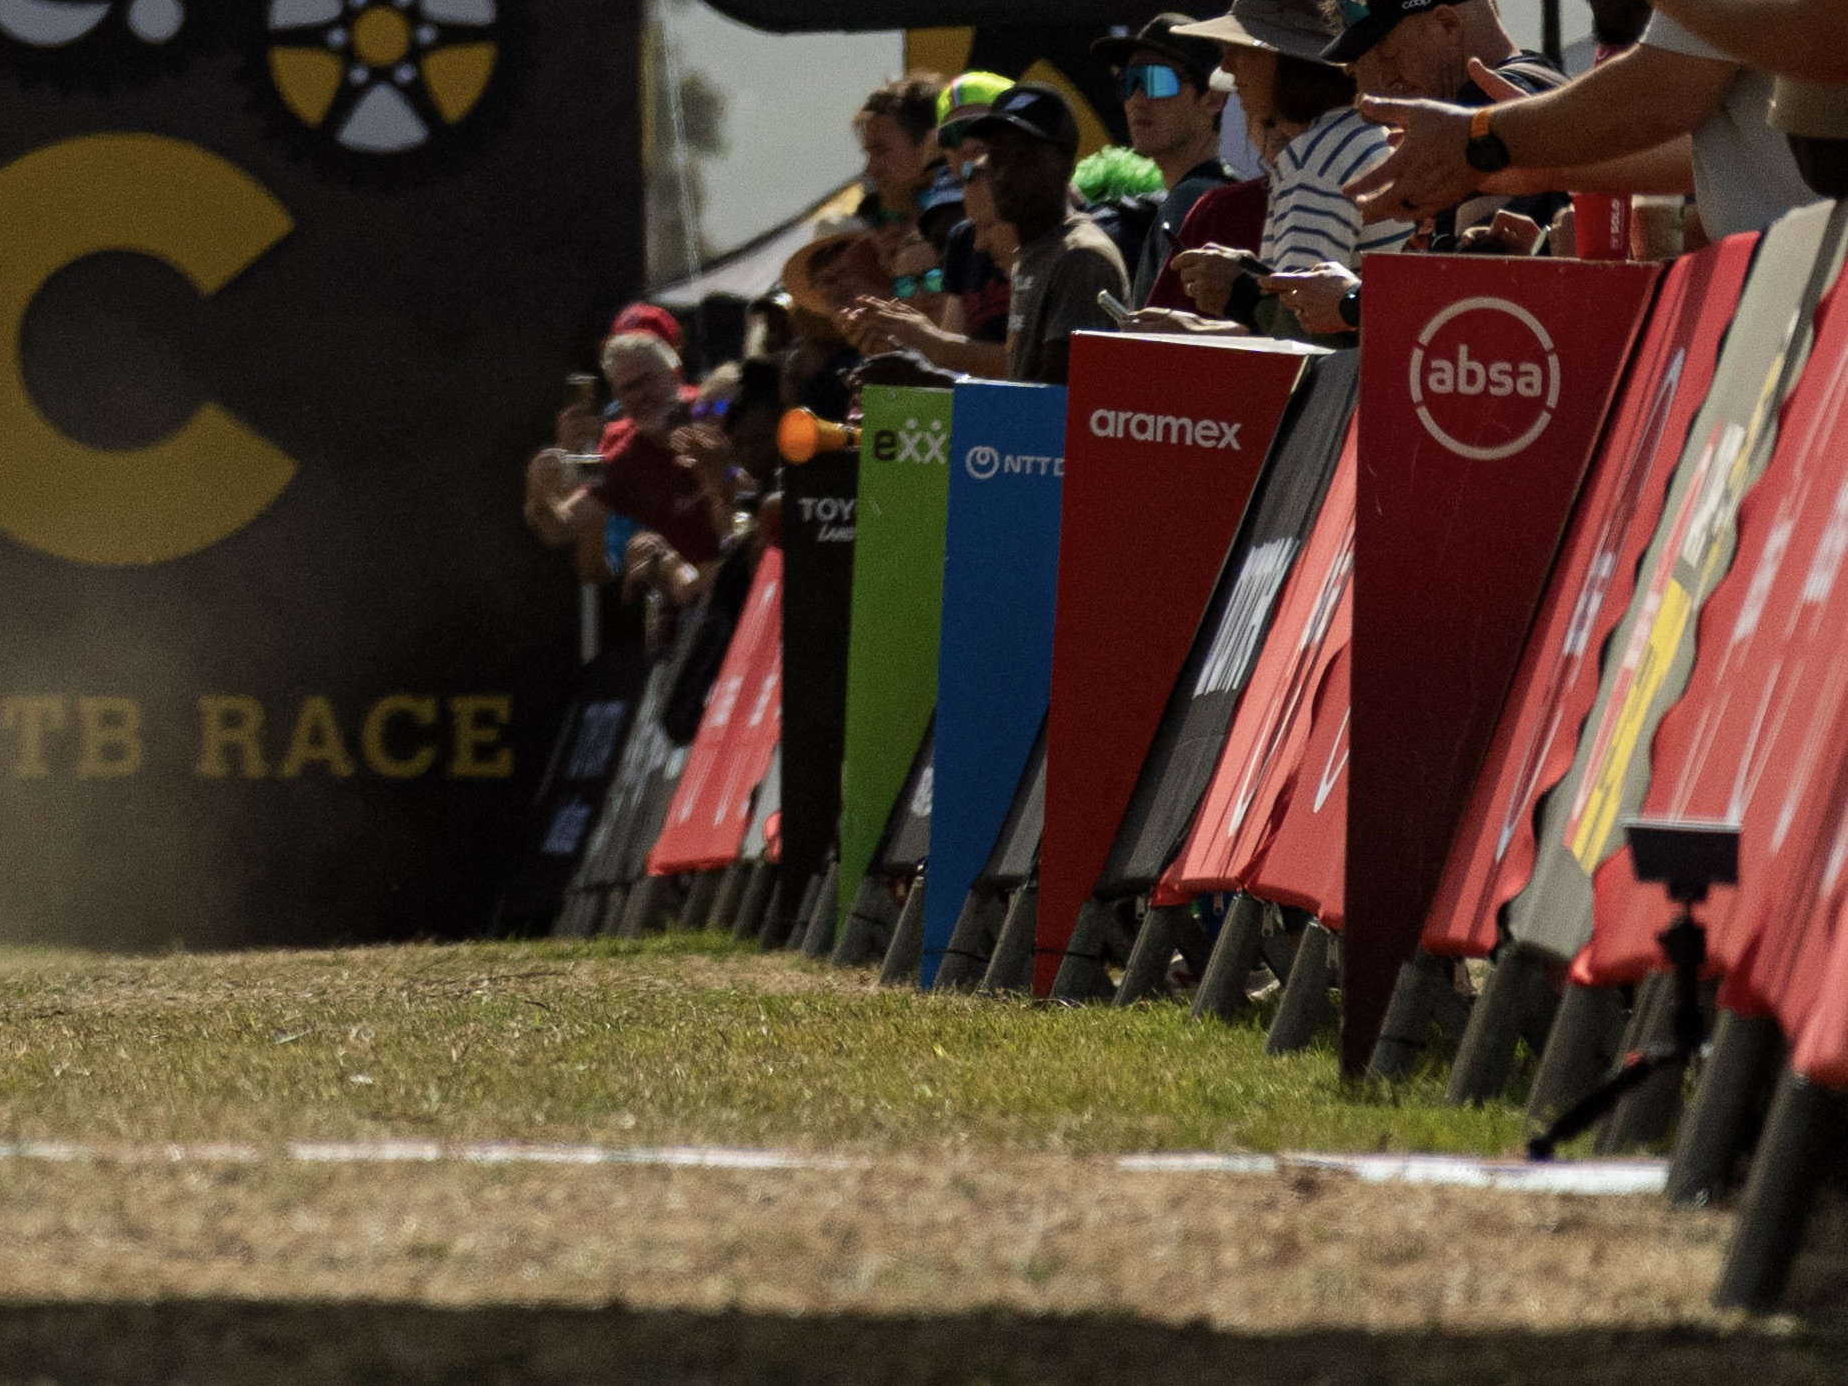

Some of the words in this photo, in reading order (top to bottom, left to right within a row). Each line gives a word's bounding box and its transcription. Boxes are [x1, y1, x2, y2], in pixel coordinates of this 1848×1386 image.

[1426, 342, 1546, 401] absa
[1089, 406, 1242, 452] aramex
[1003, 453, 1050, 476] NTT
[194, 693, 515, 780] RACE
